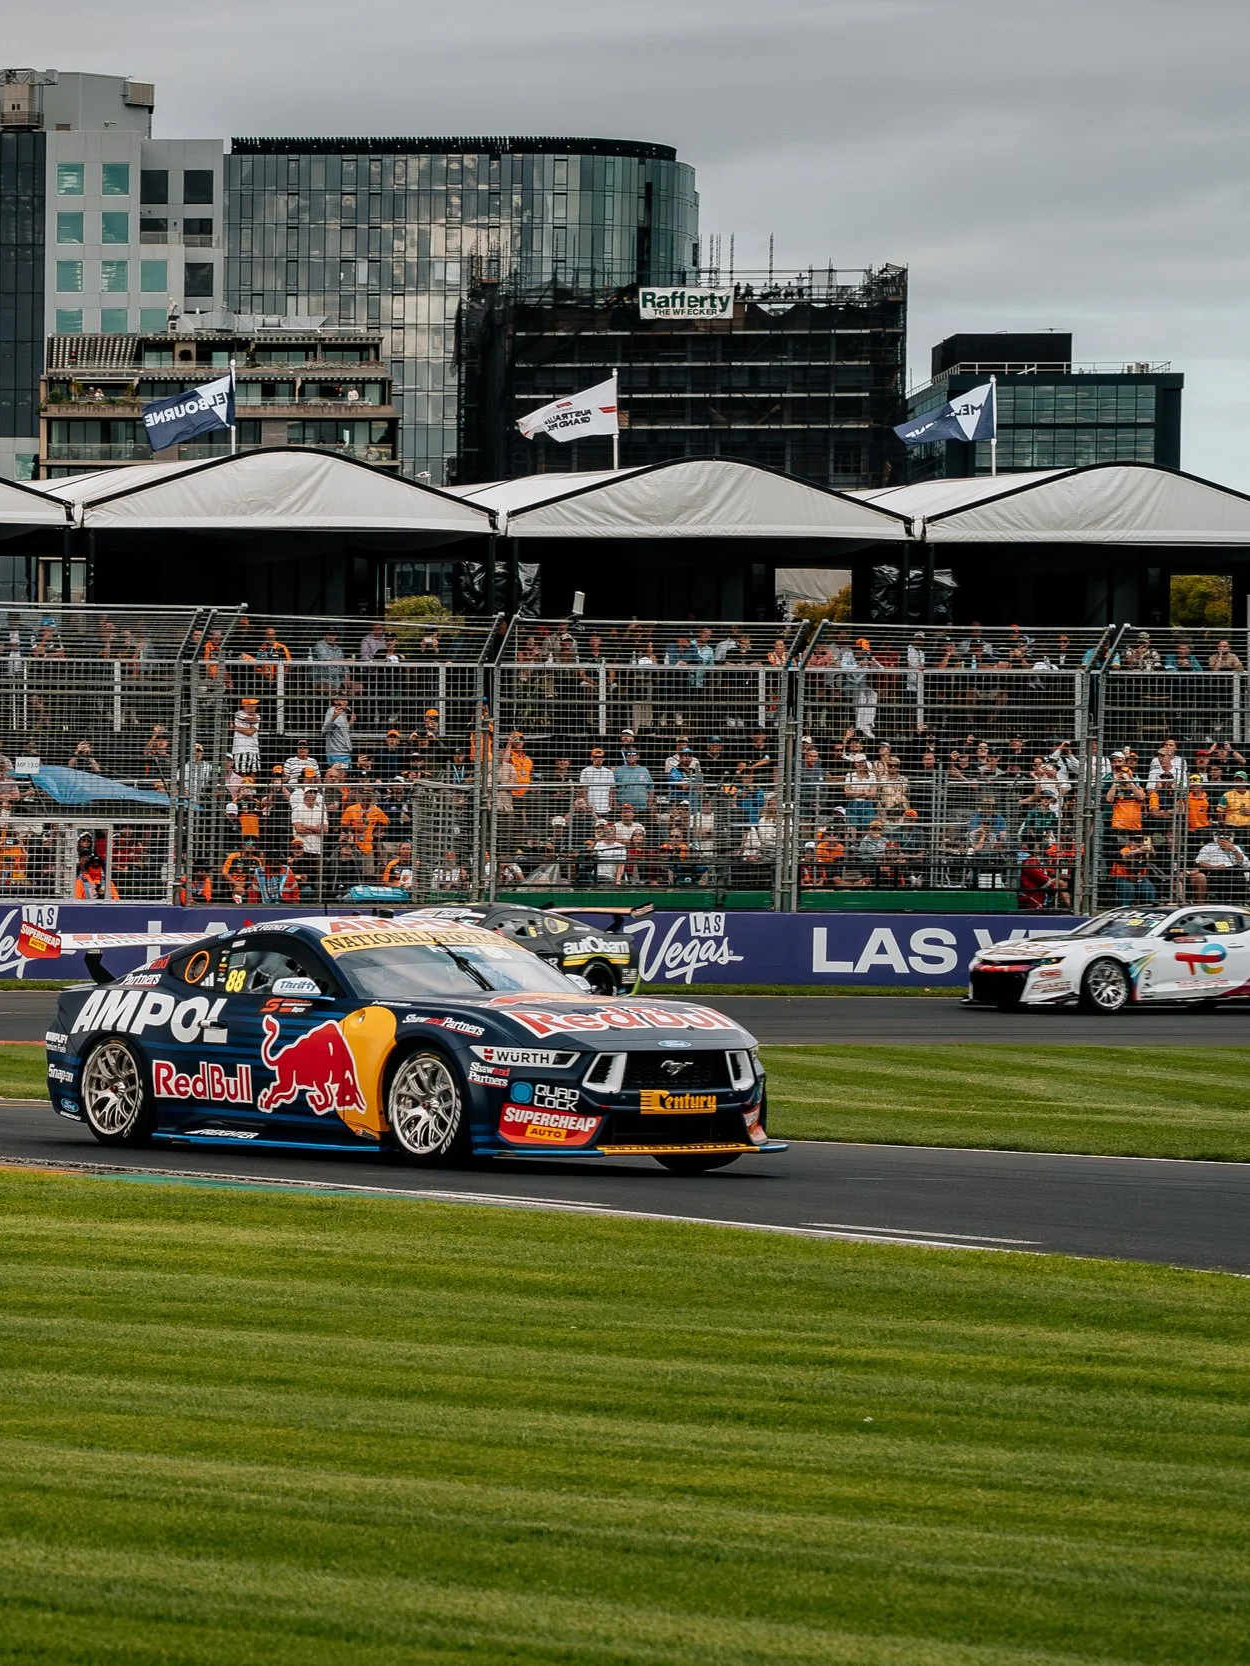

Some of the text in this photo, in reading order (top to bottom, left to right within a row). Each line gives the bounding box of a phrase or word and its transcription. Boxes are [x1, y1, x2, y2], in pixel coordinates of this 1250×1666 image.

[641, 291, 730, 312] Rafferty
[653, 308, 670, 316] THE
[26, 908, 55, 927] LAS
[694, 915, 721, 933] LAS
[20, 923, 61, 949] SUPERCHEAP
[31, 940, 45, 950] AUTO
[325, 931, 431, 950] NATIONAL
[623, 916, 744, 984] Vegas
[812, 927, 958, 974] LAS
[225, 969, 247, 992] 88
[280, 980, 316, 991] Thrifty
[70, 990, 228, 1043] AMPOL
[497, 1052, 549, 1064] WÜRTH
[468, 1071, 508, 1087] Partners
[535, 1084, 580, 1101] QUAD
[639, 1089, 717, 1114] Century
[534, 1095, 578, 1112] LOCK
[504, 1106, 597, 1132] SUPERCHEAP
[530, 1128, 562, 1138] AUTO
